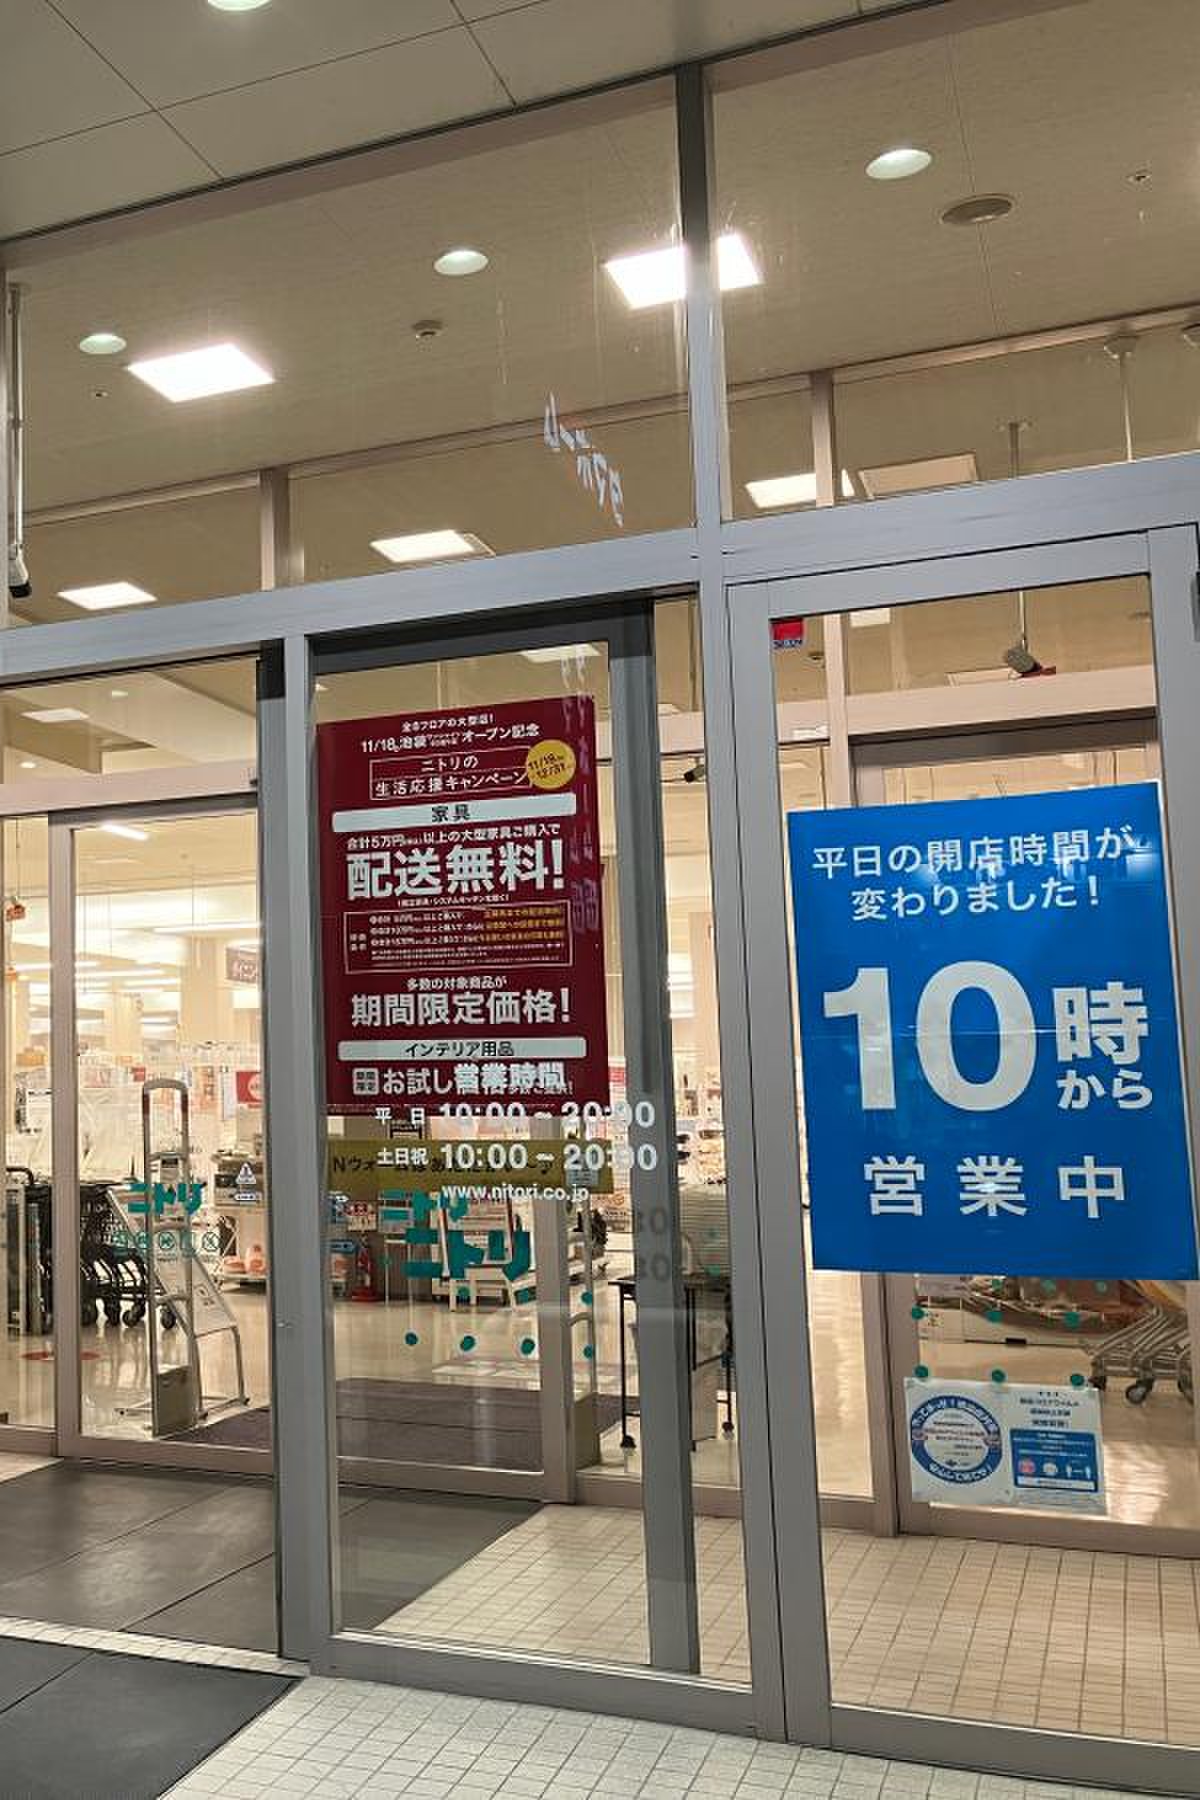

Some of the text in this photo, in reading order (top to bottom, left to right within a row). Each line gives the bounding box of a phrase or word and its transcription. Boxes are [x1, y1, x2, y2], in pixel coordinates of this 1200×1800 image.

[462, 723, 540, 743] オープン記念
[421, 755, 479, 773] ニトリの
[376, 771, 527, 797] 生活応援キャンペーン
[432, 803, 471, 823] 家具
[812, 825, 1138, 880] 平日の開店時間が
[346, 838, 565, 900] 配送無料!
[851, 874, 1101, 922] 変わりました!
[406, 976, 508, 992] 多数の対象商品が
[351, 987, 571, 1027] 期間限定価格!
[405, 1040, 515, 1058] インテリア用品
[439, 1101, 526, 1129] 10:00
[377, 1147, 430, 1167] 土日祝
[441, 1143, 528, 1170] 10:00
[563, 1143, 658, 1171] 20:00
[440, 1181, 590, 1203] www.nitori.co.jp
[863, 1154, 1127, 1219] 営業中
[405, 1229, 531, 1282] ニトリ
